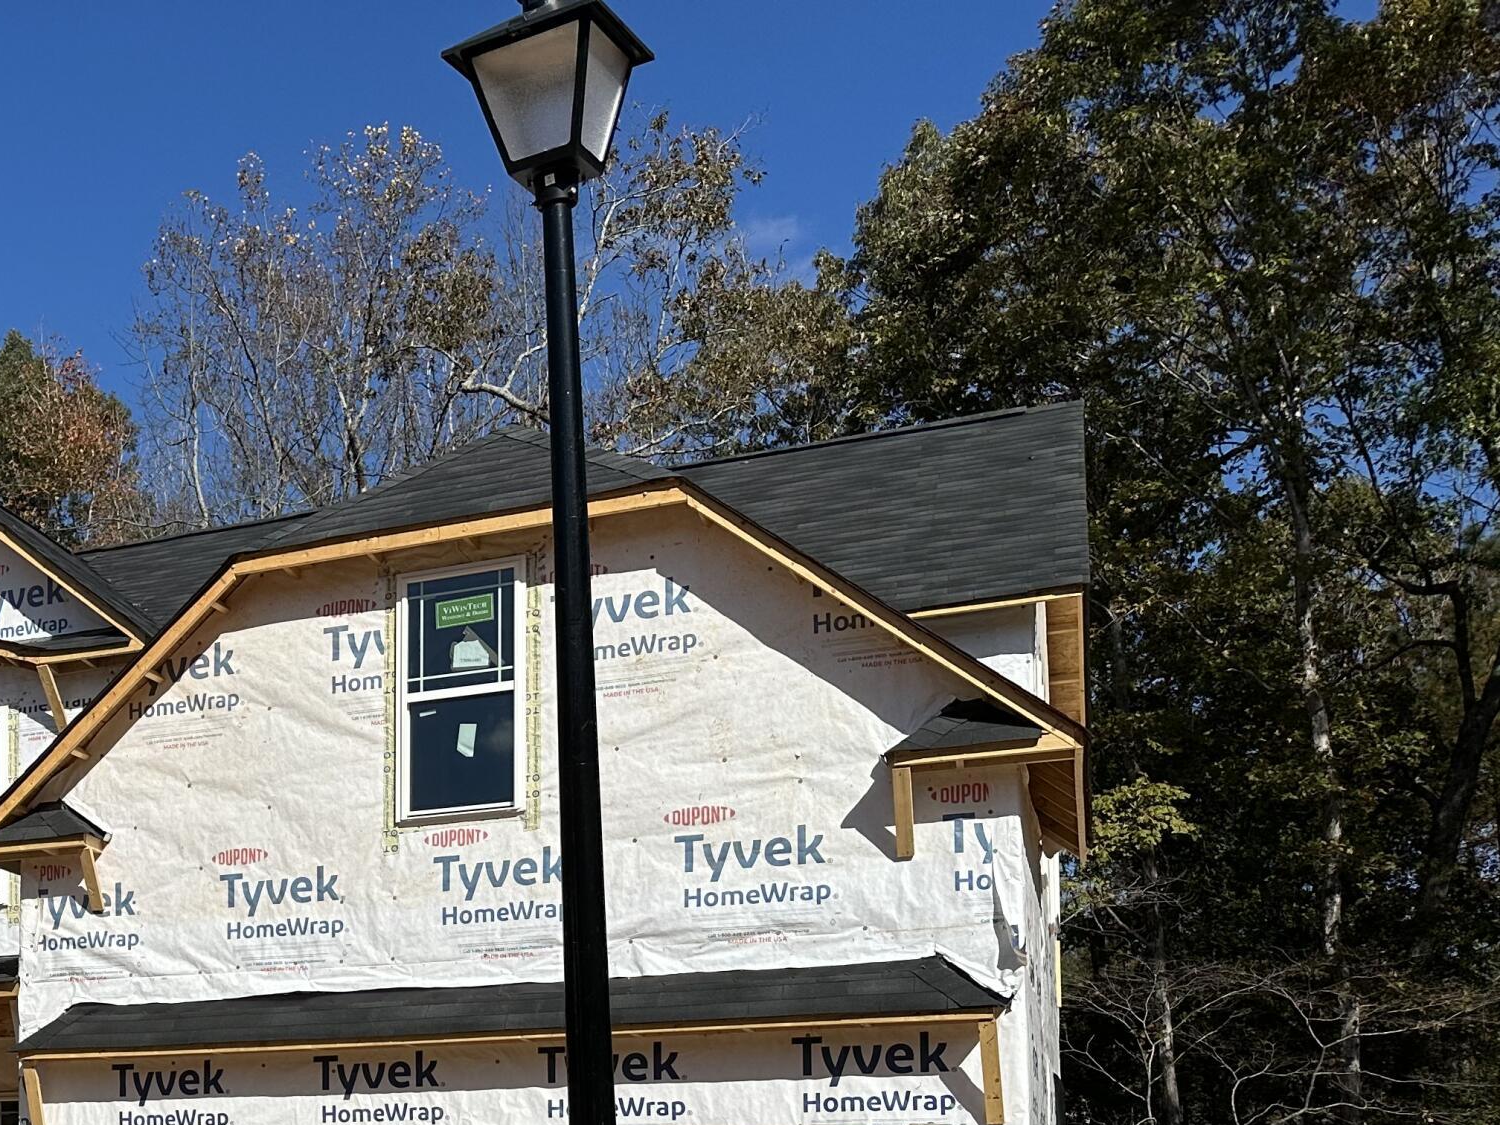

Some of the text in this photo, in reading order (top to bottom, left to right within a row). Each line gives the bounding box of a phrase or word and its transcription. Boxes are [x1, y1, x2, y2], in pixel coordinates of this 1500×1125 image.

[323, 599, 370, 617] DUPONT
[128, 691, 240, 720] HomeWrap
[672, 805, 728, 826] DUPONT
[432, 828, 481, 848] DUPONT
[218, 848, 263, 865] DUPONT
[673, 824, 825, 882] Tyvek
[433, 845, 561, 901] Tyvek
[219, 866, 340, 917] Tyvek
[683, 881, 831, 908] HomeWrap
[442, 900, 562, 925] HomeWra
[226, 917, 344, 940] HomeWrap
[792, 1031, 949, 1087] Tyvek
[111, 1060, 225, 1106] Tyvek
[313, 1050, 440, 1100] Tyvek
[321, 1103, 444, 1125] HomeWrap
[803, 1091, 957, 1116] HomeWrap
